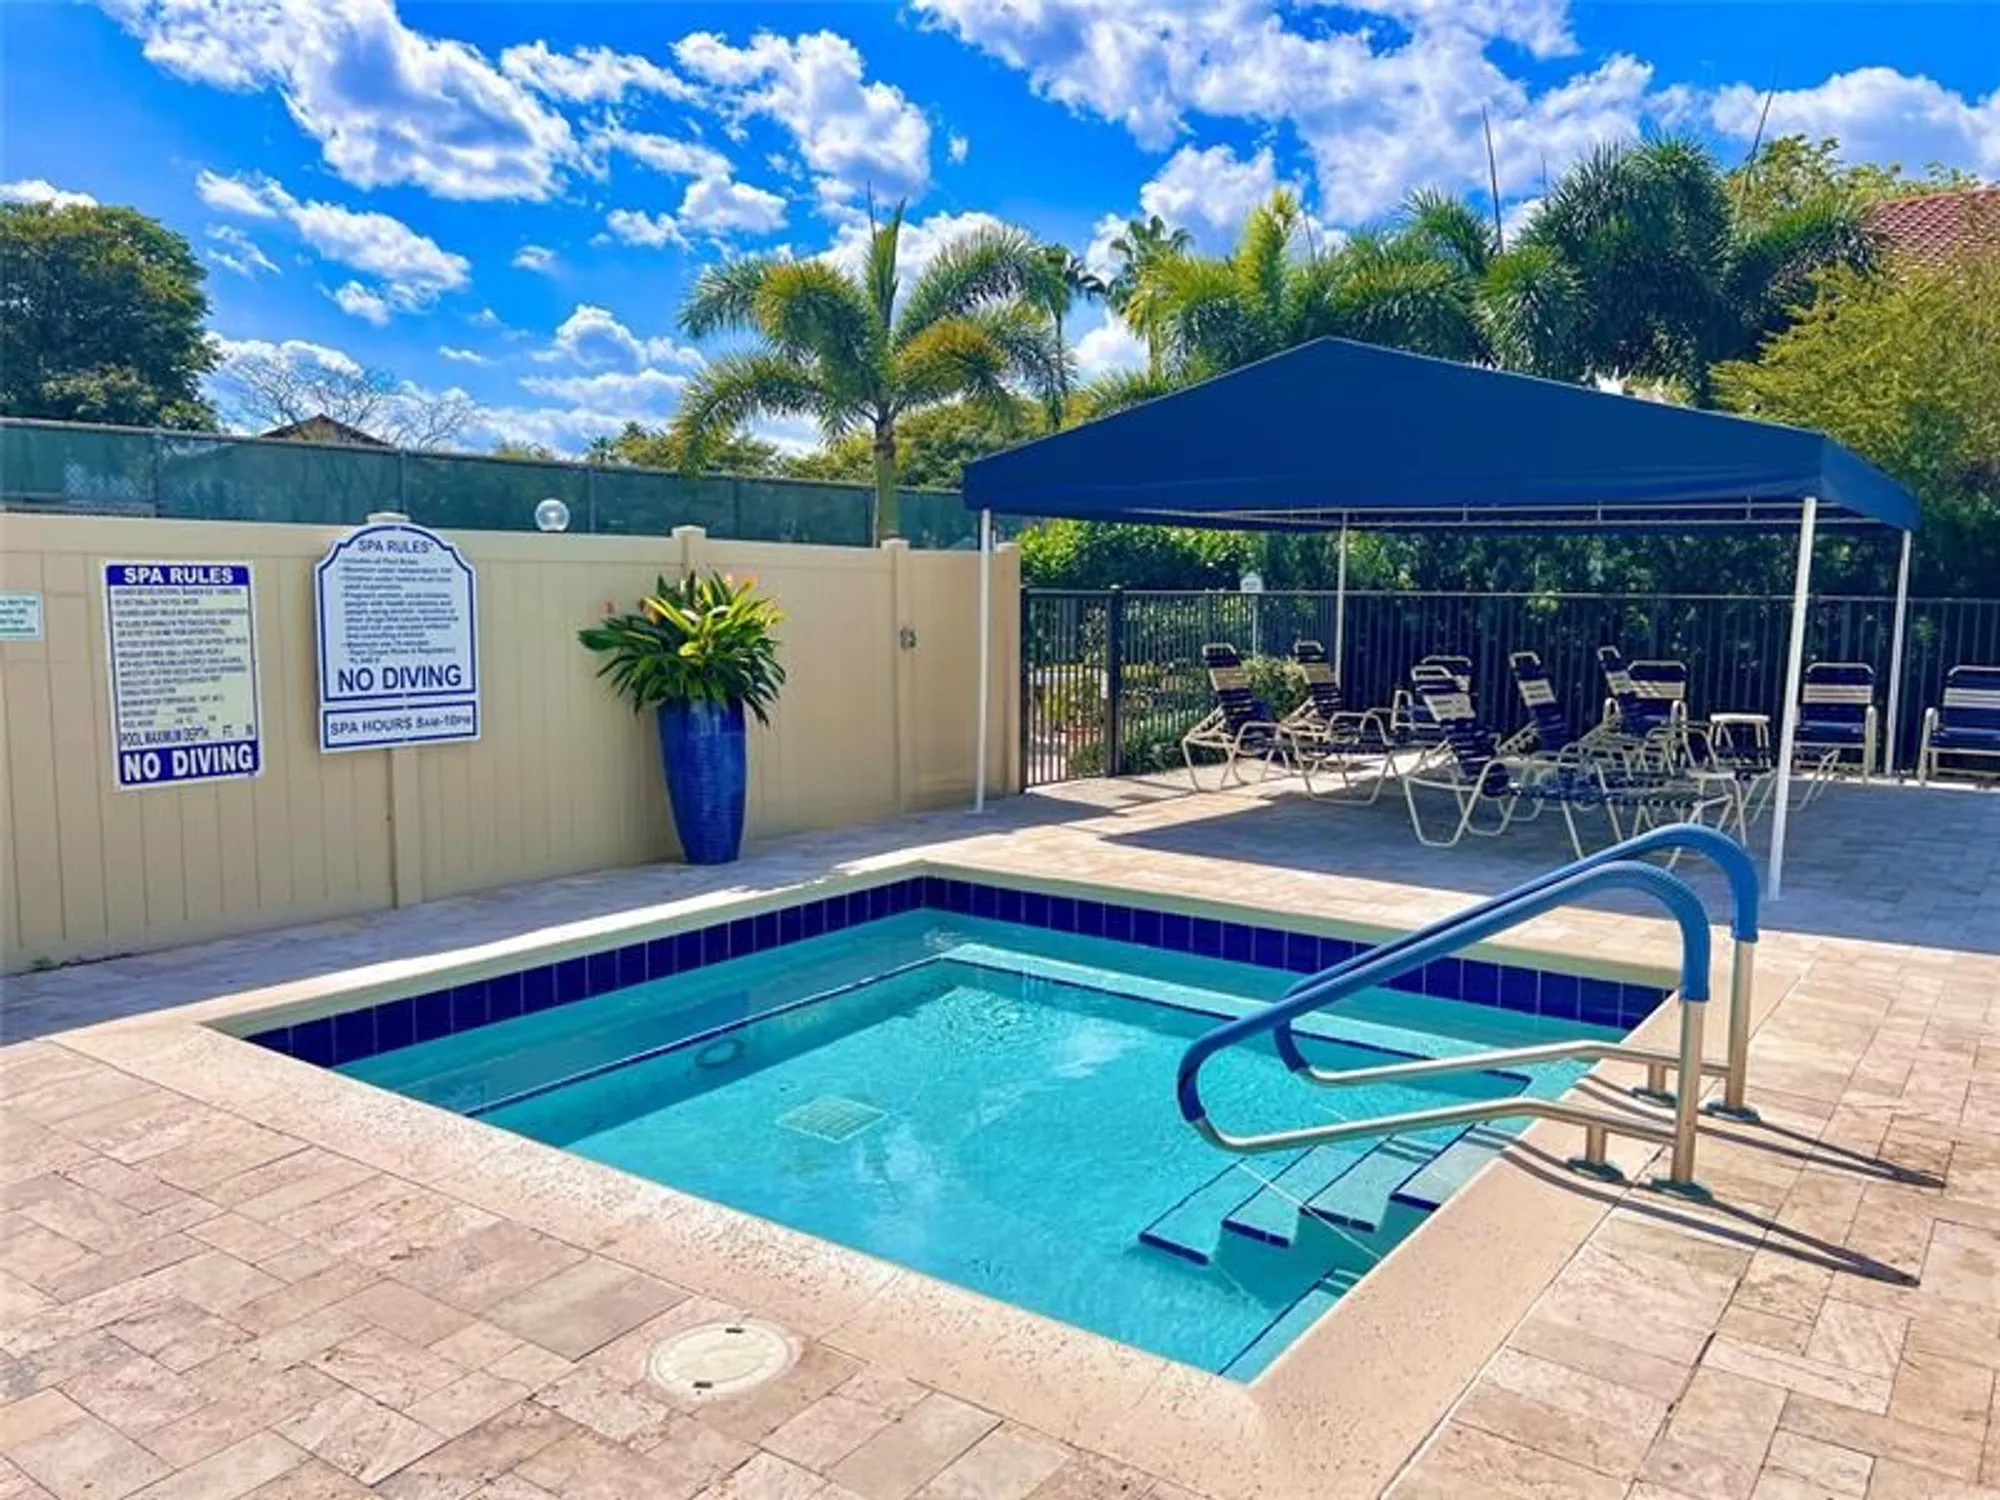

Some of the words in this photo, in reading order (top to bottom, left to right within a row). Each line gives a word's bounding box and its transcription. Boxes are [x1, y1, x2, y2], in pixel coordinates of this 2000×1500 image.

[358, 539, 384, 553] SPA
[123, 567, 164, 584] SPA
[170, 567, 233, 583] RULES
[338, 667, 374, 692] NO
[382, 664, 462, 690] DIVING
[330, 722, 358, 736] SPA
[362, 717, 413, 733] HOURS
[124, 752, 162, 782] NO
[172, 744, 254, 777] DIVING
